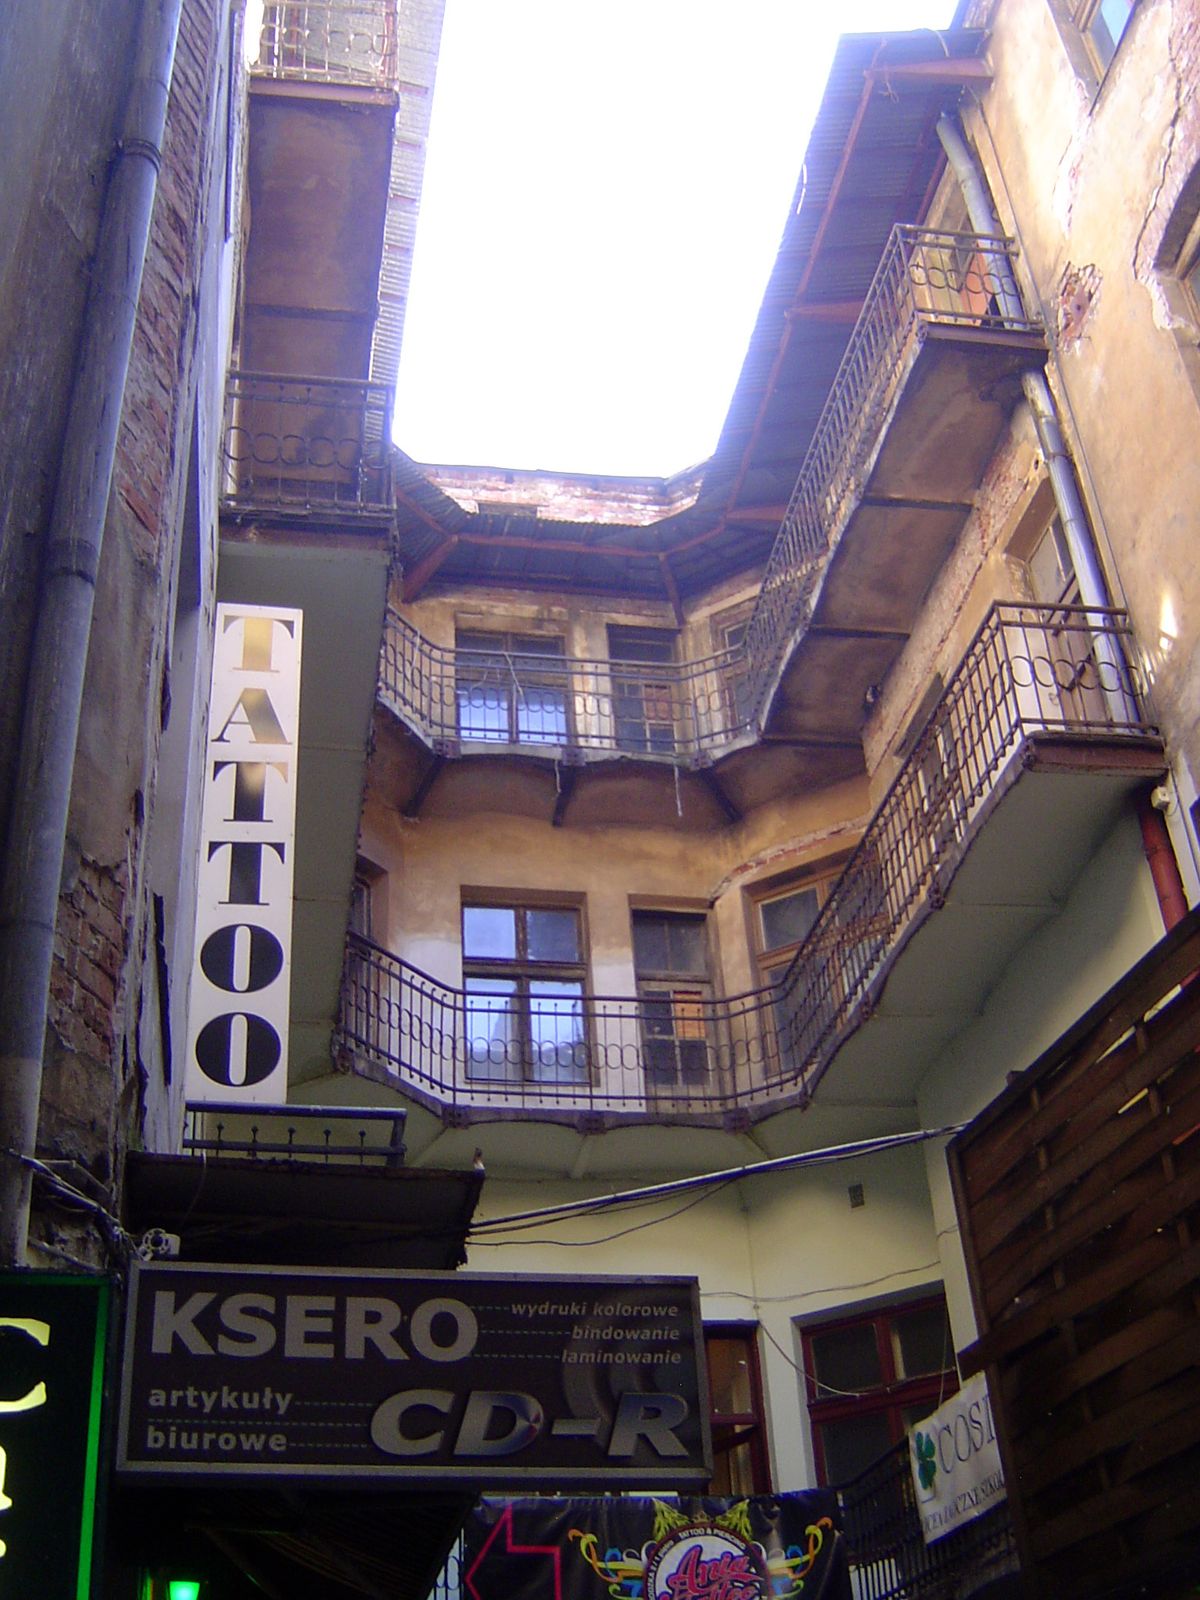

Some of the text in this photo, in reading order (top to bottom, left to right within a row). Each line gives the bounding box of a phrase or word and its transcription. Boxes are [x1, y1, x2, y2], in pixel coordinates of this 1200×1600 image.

[195, 614, 296, 1087] TATTOO
[511, 1302, 679, 1318] wydruki kolorowe
[151, 1290, 478, 1362] KSERO
[572, 1326, 680, 1340] bindowanie
[561, 1350, 681, 1364] laminowanie
[148, 1386, 293, 1415] artykuły
[370, 1388, 690, 1458] CD-R
[147, 1425, 288, 1451] biurowe
[678, 1528, 705, 1539] TATTOO
